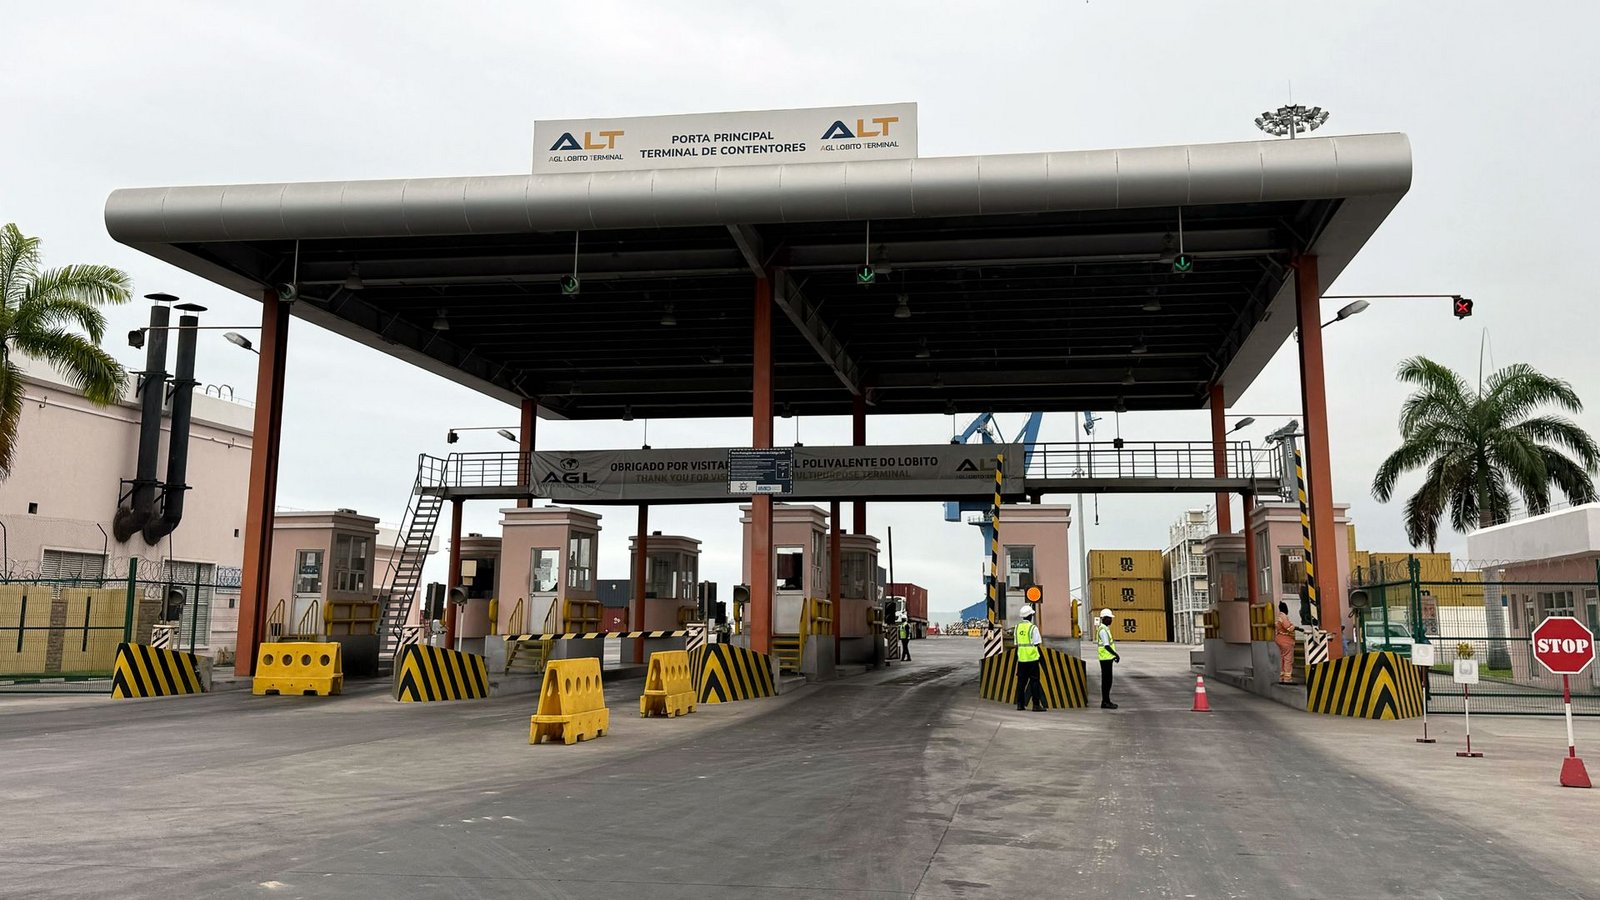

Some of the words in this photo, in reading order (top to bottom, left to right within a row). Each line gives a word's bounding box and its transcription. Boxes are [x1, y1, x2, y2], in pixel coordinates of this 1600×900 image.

[821, 117, 899, 139] ALT
[549, 131, 625, 151] ALT
[672, 134, 711, 144] PORTA
[714, 131, 774, 143] PRINCIPAL
[640, 148, 698, 158] TERMINAL
[702, 147, 717, 156] DE
[721, 143, 806, 155] CONTENTORES
[836, 143, 862, 151] LOBITO
[863, 141, 899, 149] TERMINAL
[611, 461, 664, 472] OBRIGADO
[667, 461, 688, 471] POR
[803, 457, 877, 468] POLIVALENTE
[880, 457, 896, 467] DO
[899, 457, 938, 466] LOBITO
[541, 472, 597, 484] AGL
[636, 473, 667, 483] THANK
[669, 473, 689, 482] YOU
[690, 473, 710, 481] FOR
[792, 470, 860, 481] ULTIPURPOSE
[862, 469, 911, 479] TERMINAL
[1537, 638, 1589, 653] STOP
